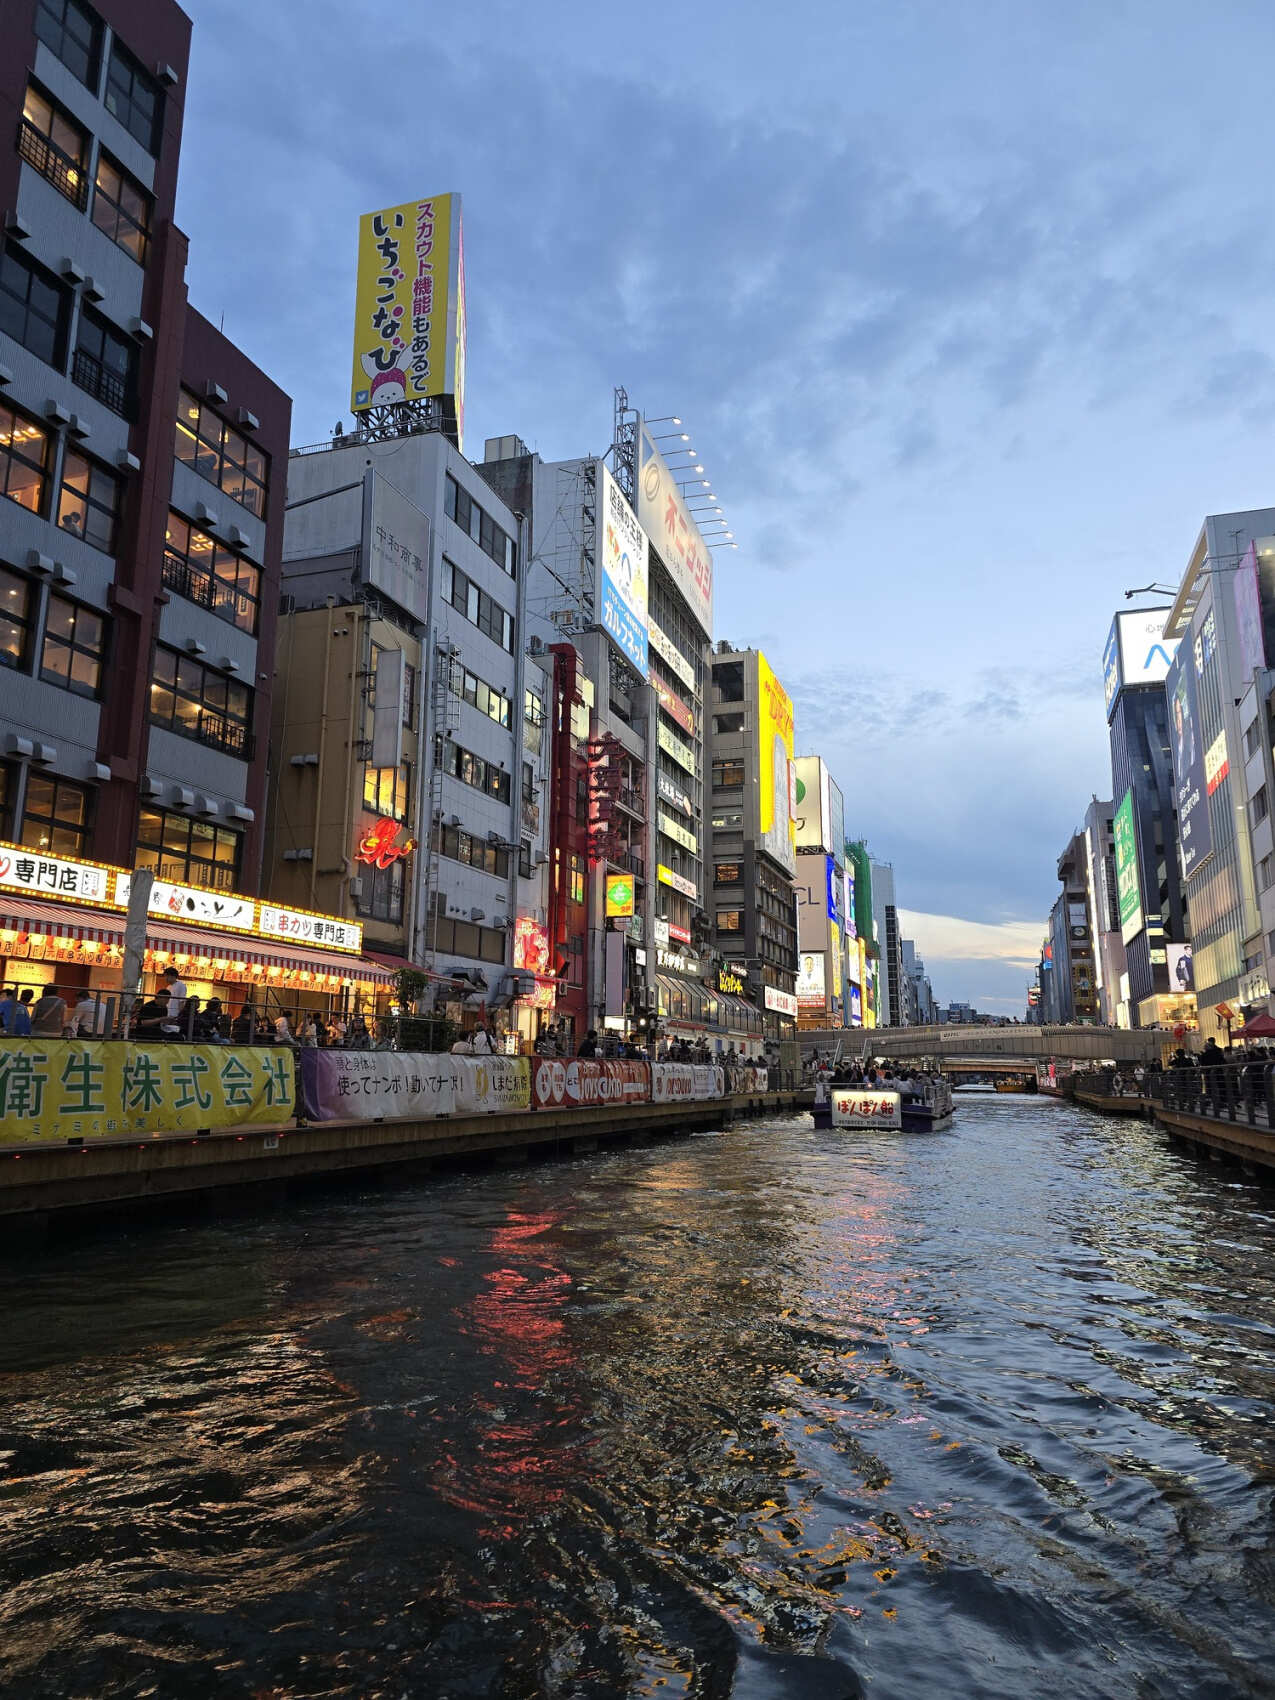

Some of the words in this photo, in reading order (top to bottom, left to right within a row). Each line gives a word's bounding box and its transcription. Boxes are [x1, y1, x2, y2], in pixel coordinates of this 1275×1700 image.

[367, 213, 405, 372] いちごなび
[411, 202, 435, 392] スカウト機能もあるで
[278, 913, 346, 944] 串カツ専門店
[0, 1051, 292, 1118] 衛生株式会社
